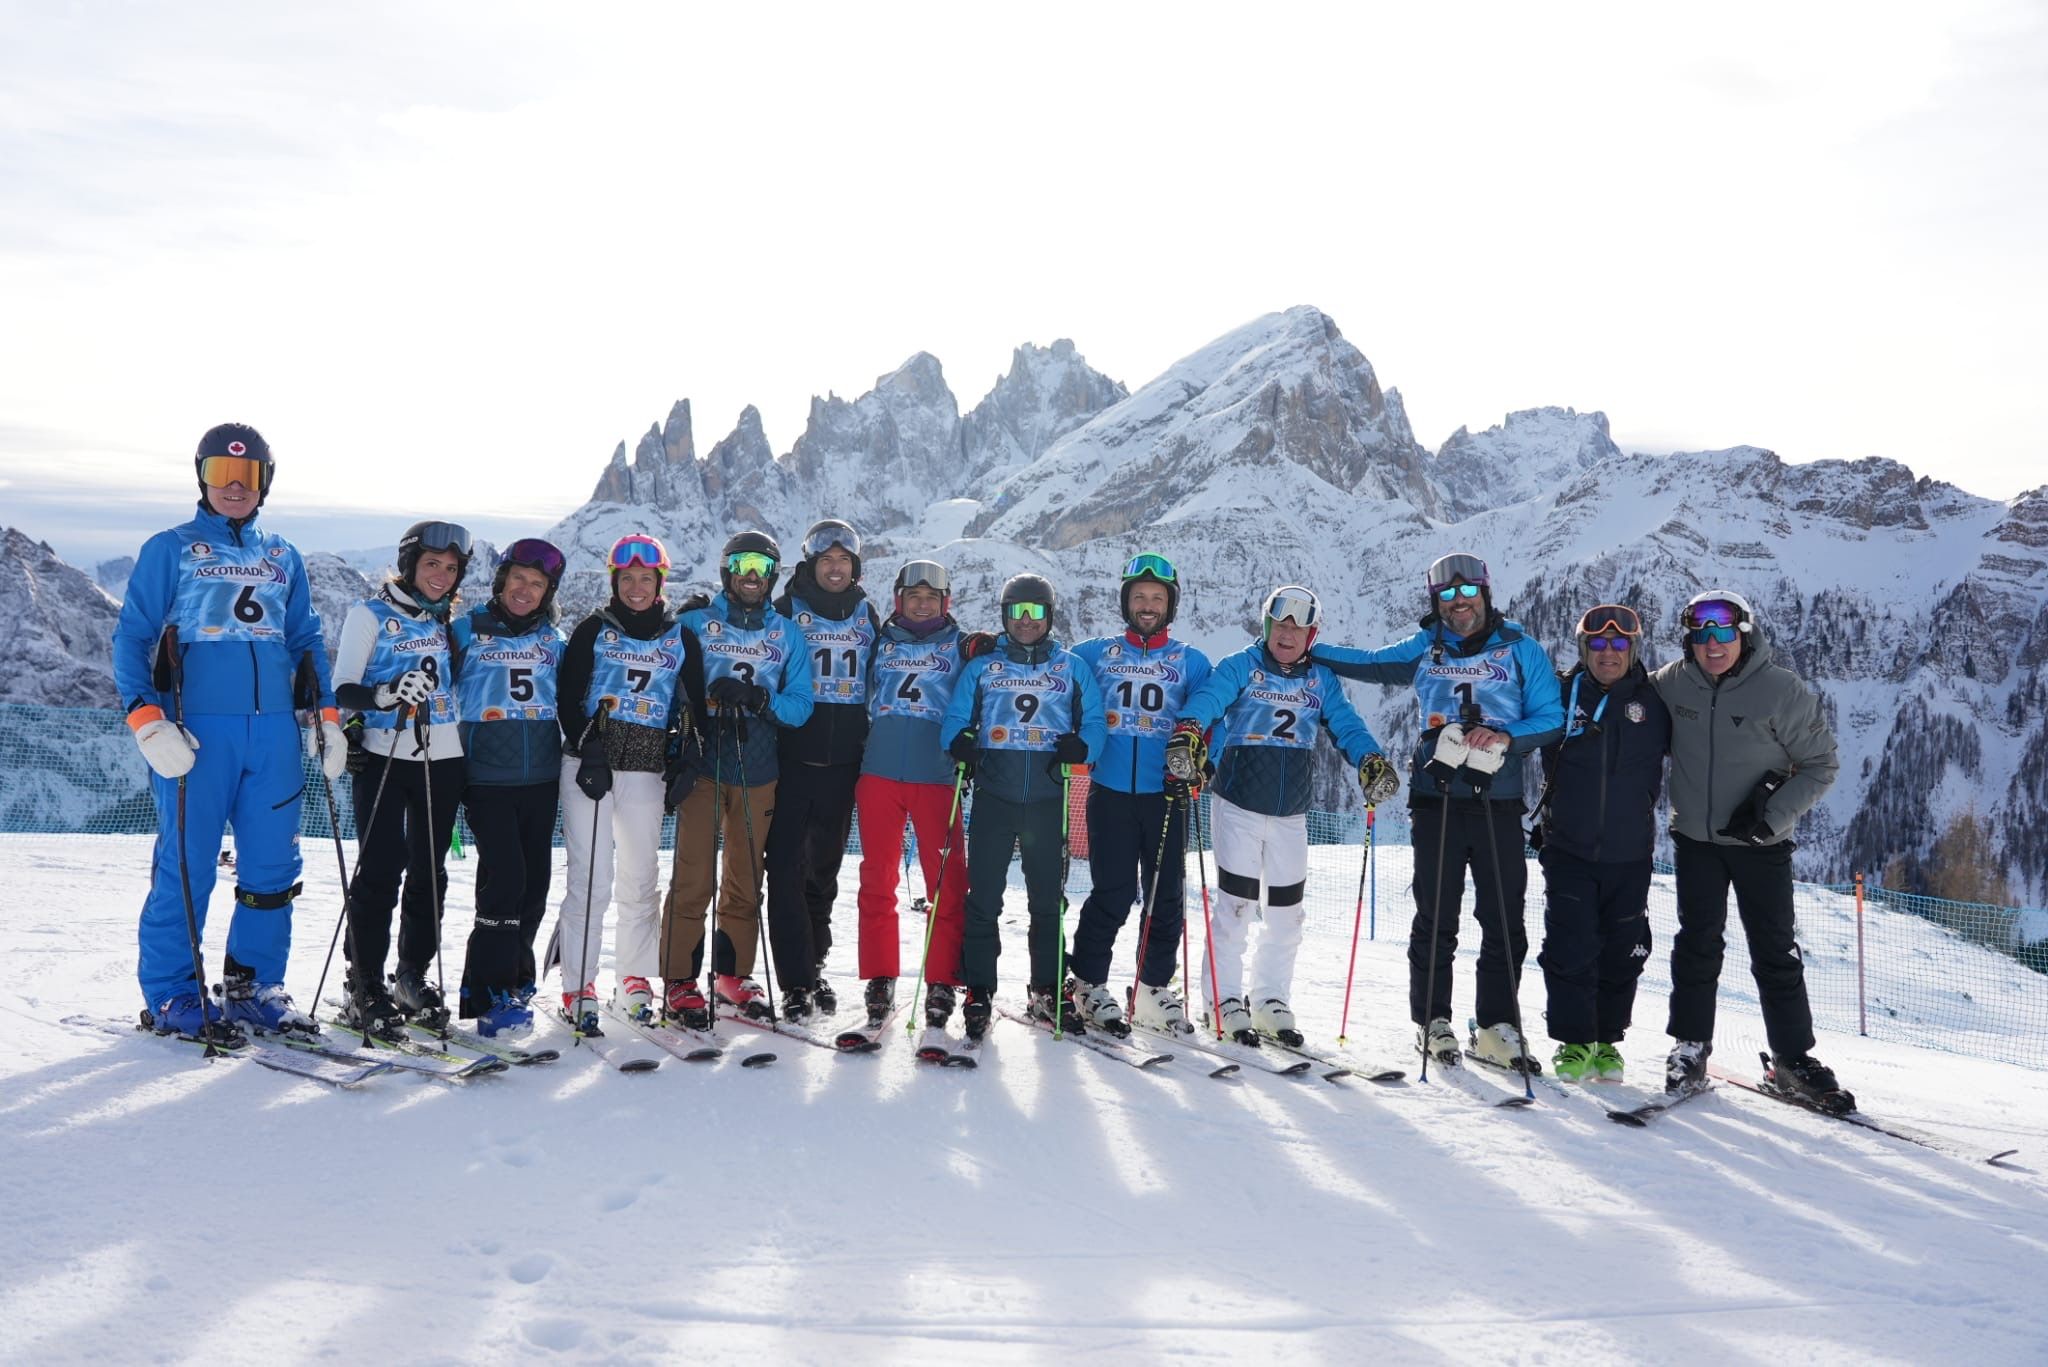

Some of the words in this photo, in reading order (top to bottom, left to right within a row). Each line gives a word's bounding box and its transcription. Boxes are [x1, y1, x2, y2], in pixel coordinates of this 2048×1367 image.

[195, 566, 267, 577] ASCOTRADE
[234, 585, 264, 623] 6
[393, 637, 440, 652] ASCOTRADE
[804, 633, 853, 642] SCOTRADE
[479, 651, 537, 661] ASCOTRADE
[604, 650, 657, 664] ASCOTRADE
[708, 643, 761, 656] ASCOTRADE
[814, 648, 857, 678] 11
[881, 659, 930, 669] ASCOTRADE
[1106, 665, 1158, 676] ASCOTRADE
[1427, 667, 1485, 676] ASCOTRADE
[421, 656, 438, 692] 8
[627, 668, 652, 693] 7
[732, 661, 754, 686] 3
[510, 668, 534, 702] 5
[897, 673, 922, 703] 4
[990, 679, 1044, 688] ASCOTRADE
[1117, 681, 1163, 712] 10
[1250, 690, 1302, 703] ASCOTRADE
[1453, 683, 1472, 705] 1
[1015, 693, 1039, 723] 9
[1272, 709, 1296, 739] 2
